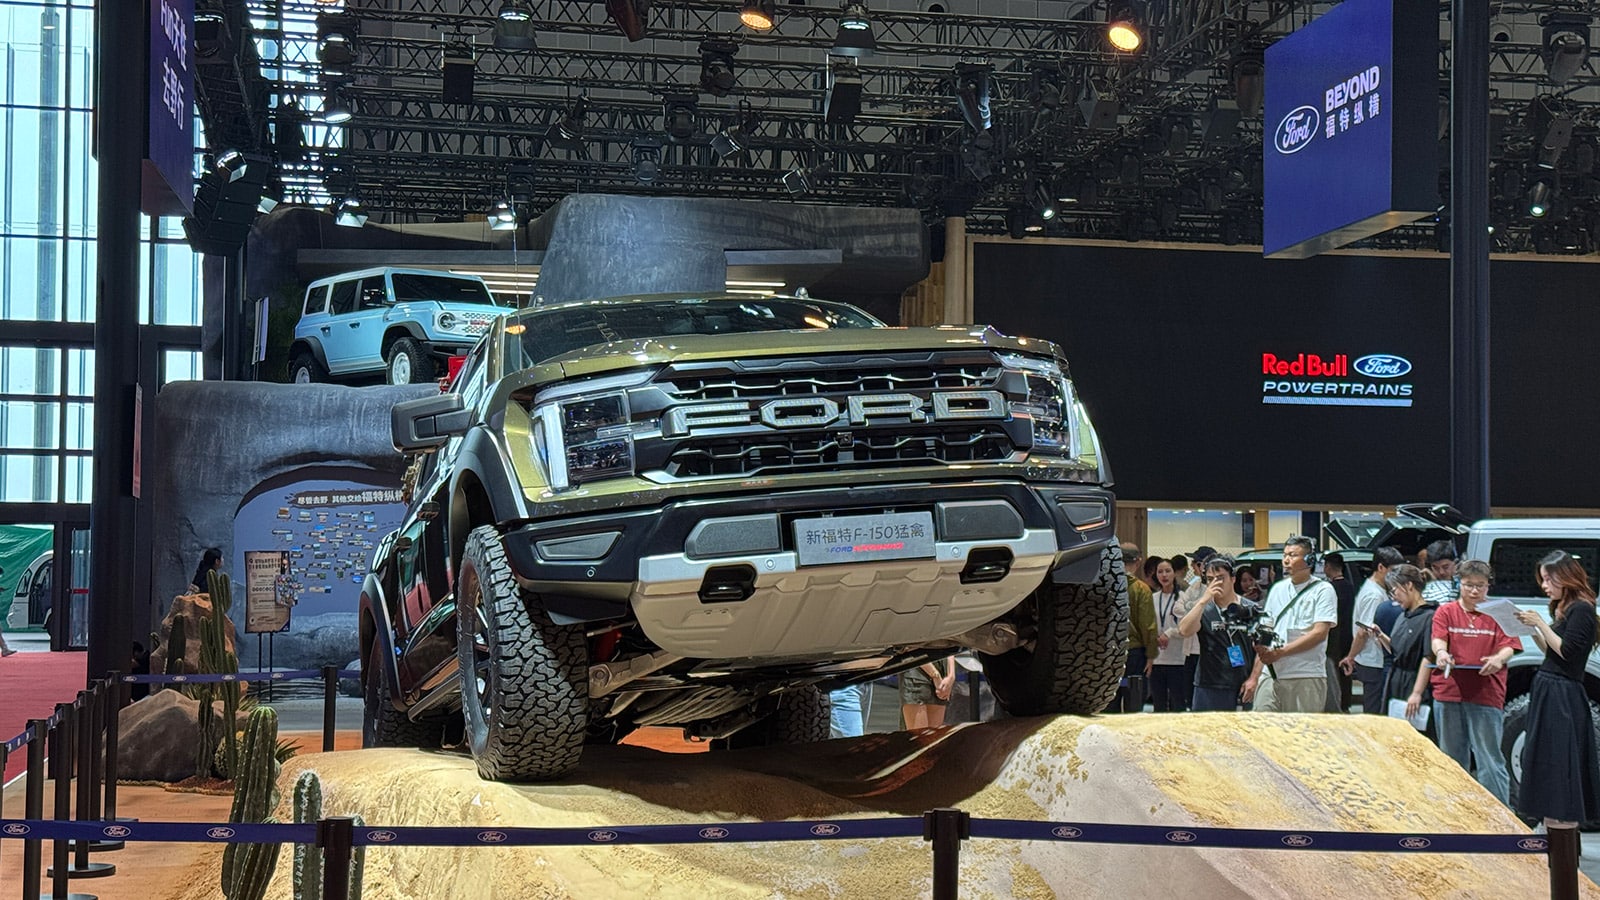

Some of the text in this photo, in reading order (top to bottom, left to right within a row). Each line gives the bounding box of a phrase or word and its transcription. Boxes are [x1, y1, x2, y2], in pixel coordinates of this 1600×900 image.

[1325, 65, 1380, 113] BEYOND
[1325, 92, 1380, 139] 福特纵横
[1282, 112, 1312, 149] Ford
[1262, 353, 1401, 377] Red Bull Ford
[1262, 381, 1413, 396] POWERTRAINS
[663, 391, 1008, 439] FORD
[805, 522, 925, 545] 新福特F-150猛禽
[7, 824, 25, 834] Ford
[108, 826, 126, 836] Ford
[211, 827, 230, 838] Ford
[704, 828, 723, 838] Ford
[815, 824, 834, 835] Ford
[1057, 827, 1076, 837] Ford
[372, 831, 391, 841] Ford
[593, 831, 612, 841] Ford
[1171, 831, 1191, 842] Ford
[1287, 835, 1307, 845] Ford
[1404, 837, 1425, 848] Ford
